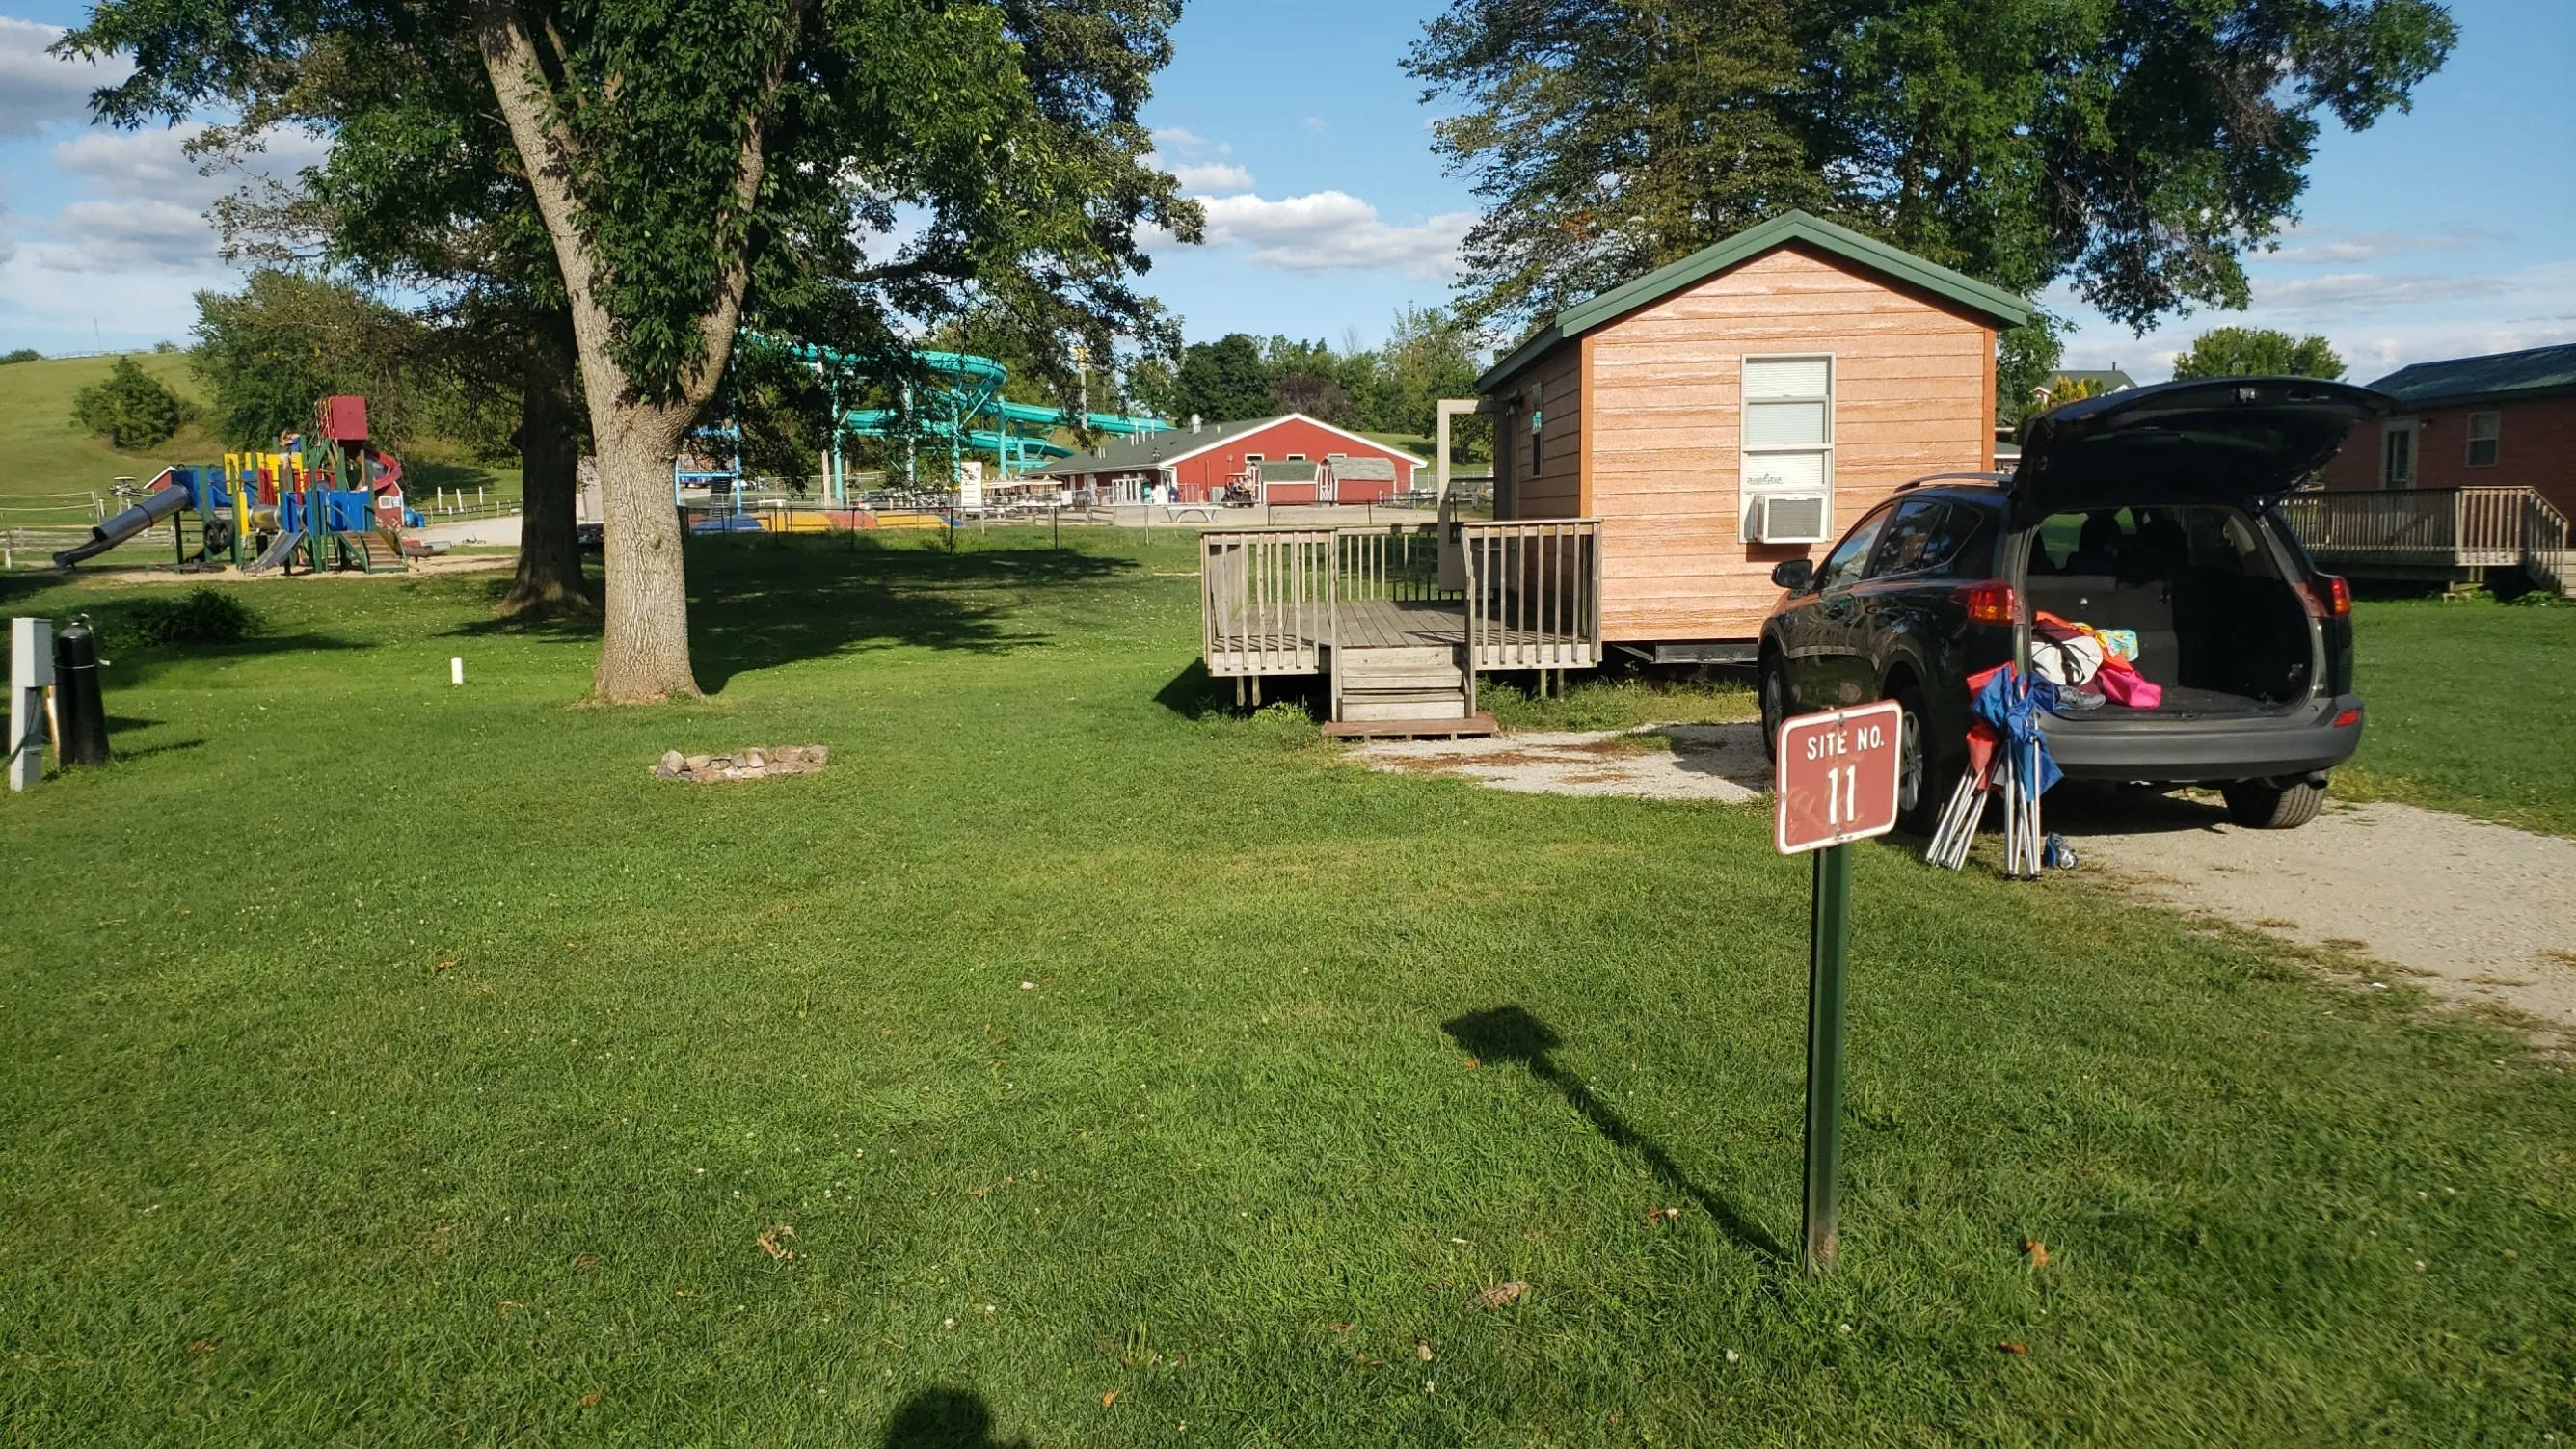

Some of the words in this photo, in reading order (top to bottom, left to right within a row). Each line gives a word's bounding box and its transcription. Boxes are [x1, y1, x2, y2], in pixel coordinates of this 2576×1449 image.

[1806, 731, 1848, 761] SITE
[1857, 725, 1885, 752] NO.
[1828, 765, 1856, 825] 11
